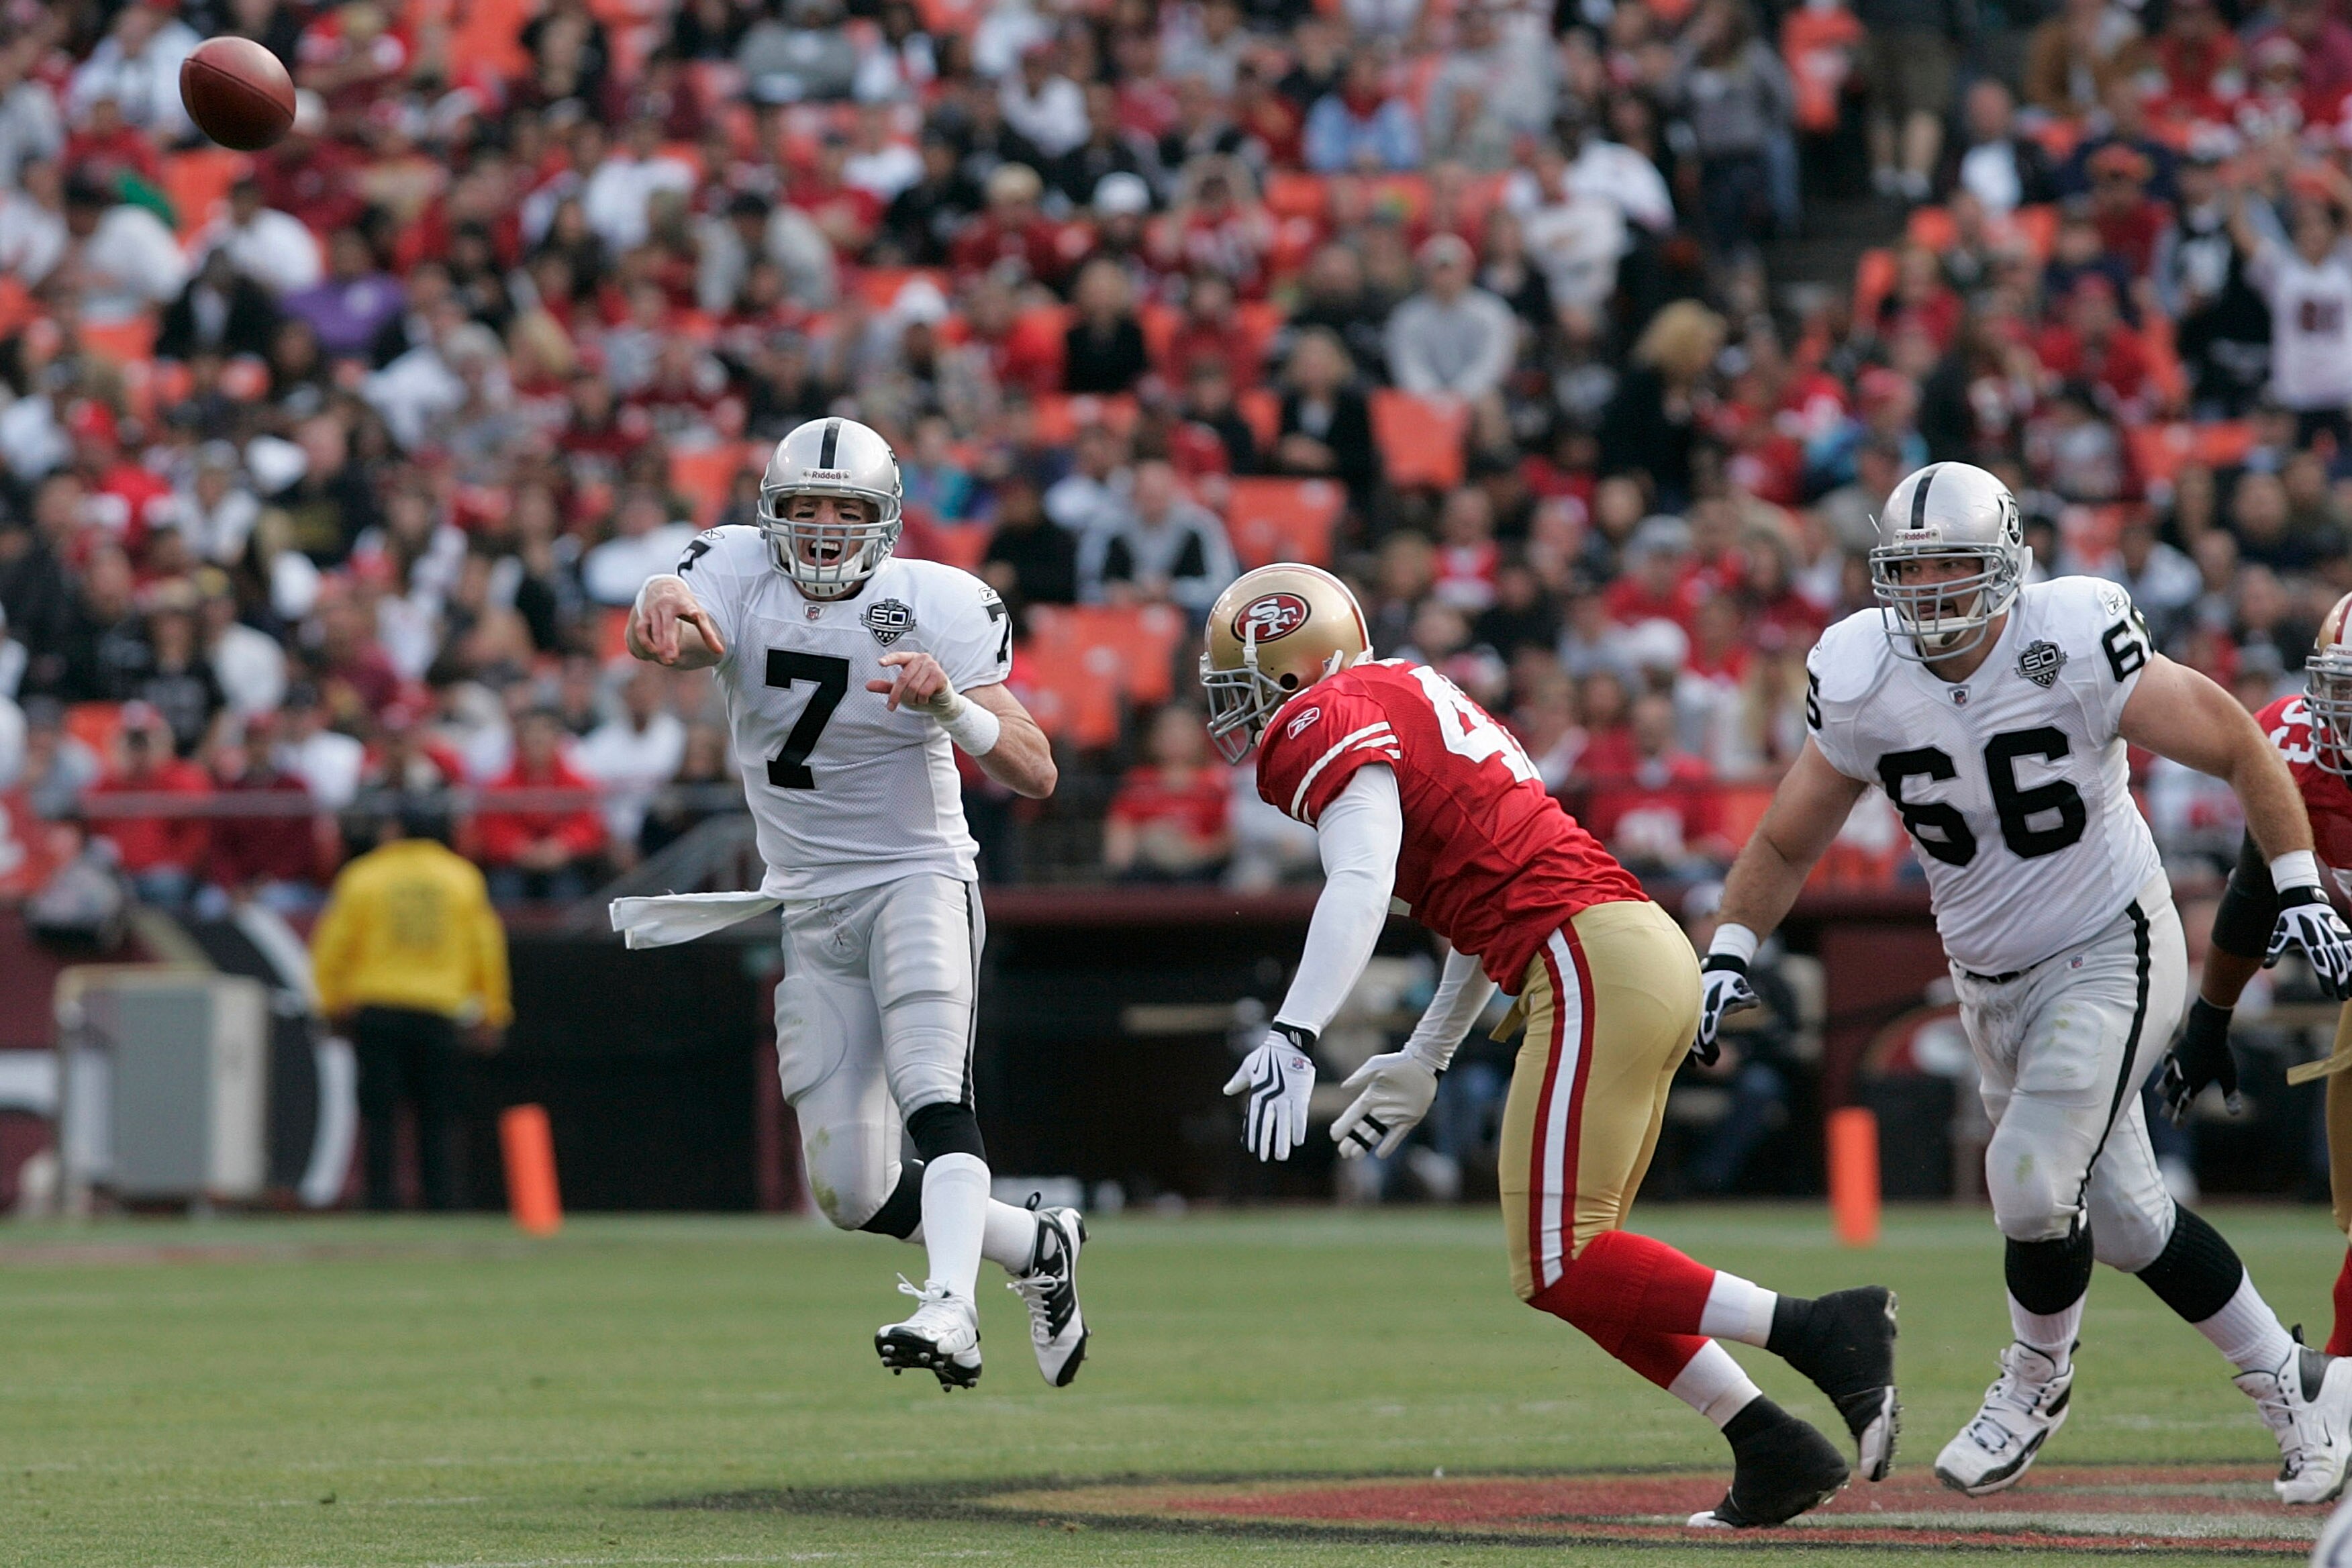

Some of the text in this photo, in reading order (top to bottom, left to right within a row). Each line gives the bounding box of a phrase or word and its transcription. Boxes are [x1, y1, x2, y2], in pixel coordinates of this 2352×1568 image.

[871, 609, 906, 625] 50
[1248, 598, 1297, 637] SF
[2023, 648, 2057, 671] 50
[765, 648, 850, 790] 7
[1877, 726, 2087, 867] 66
